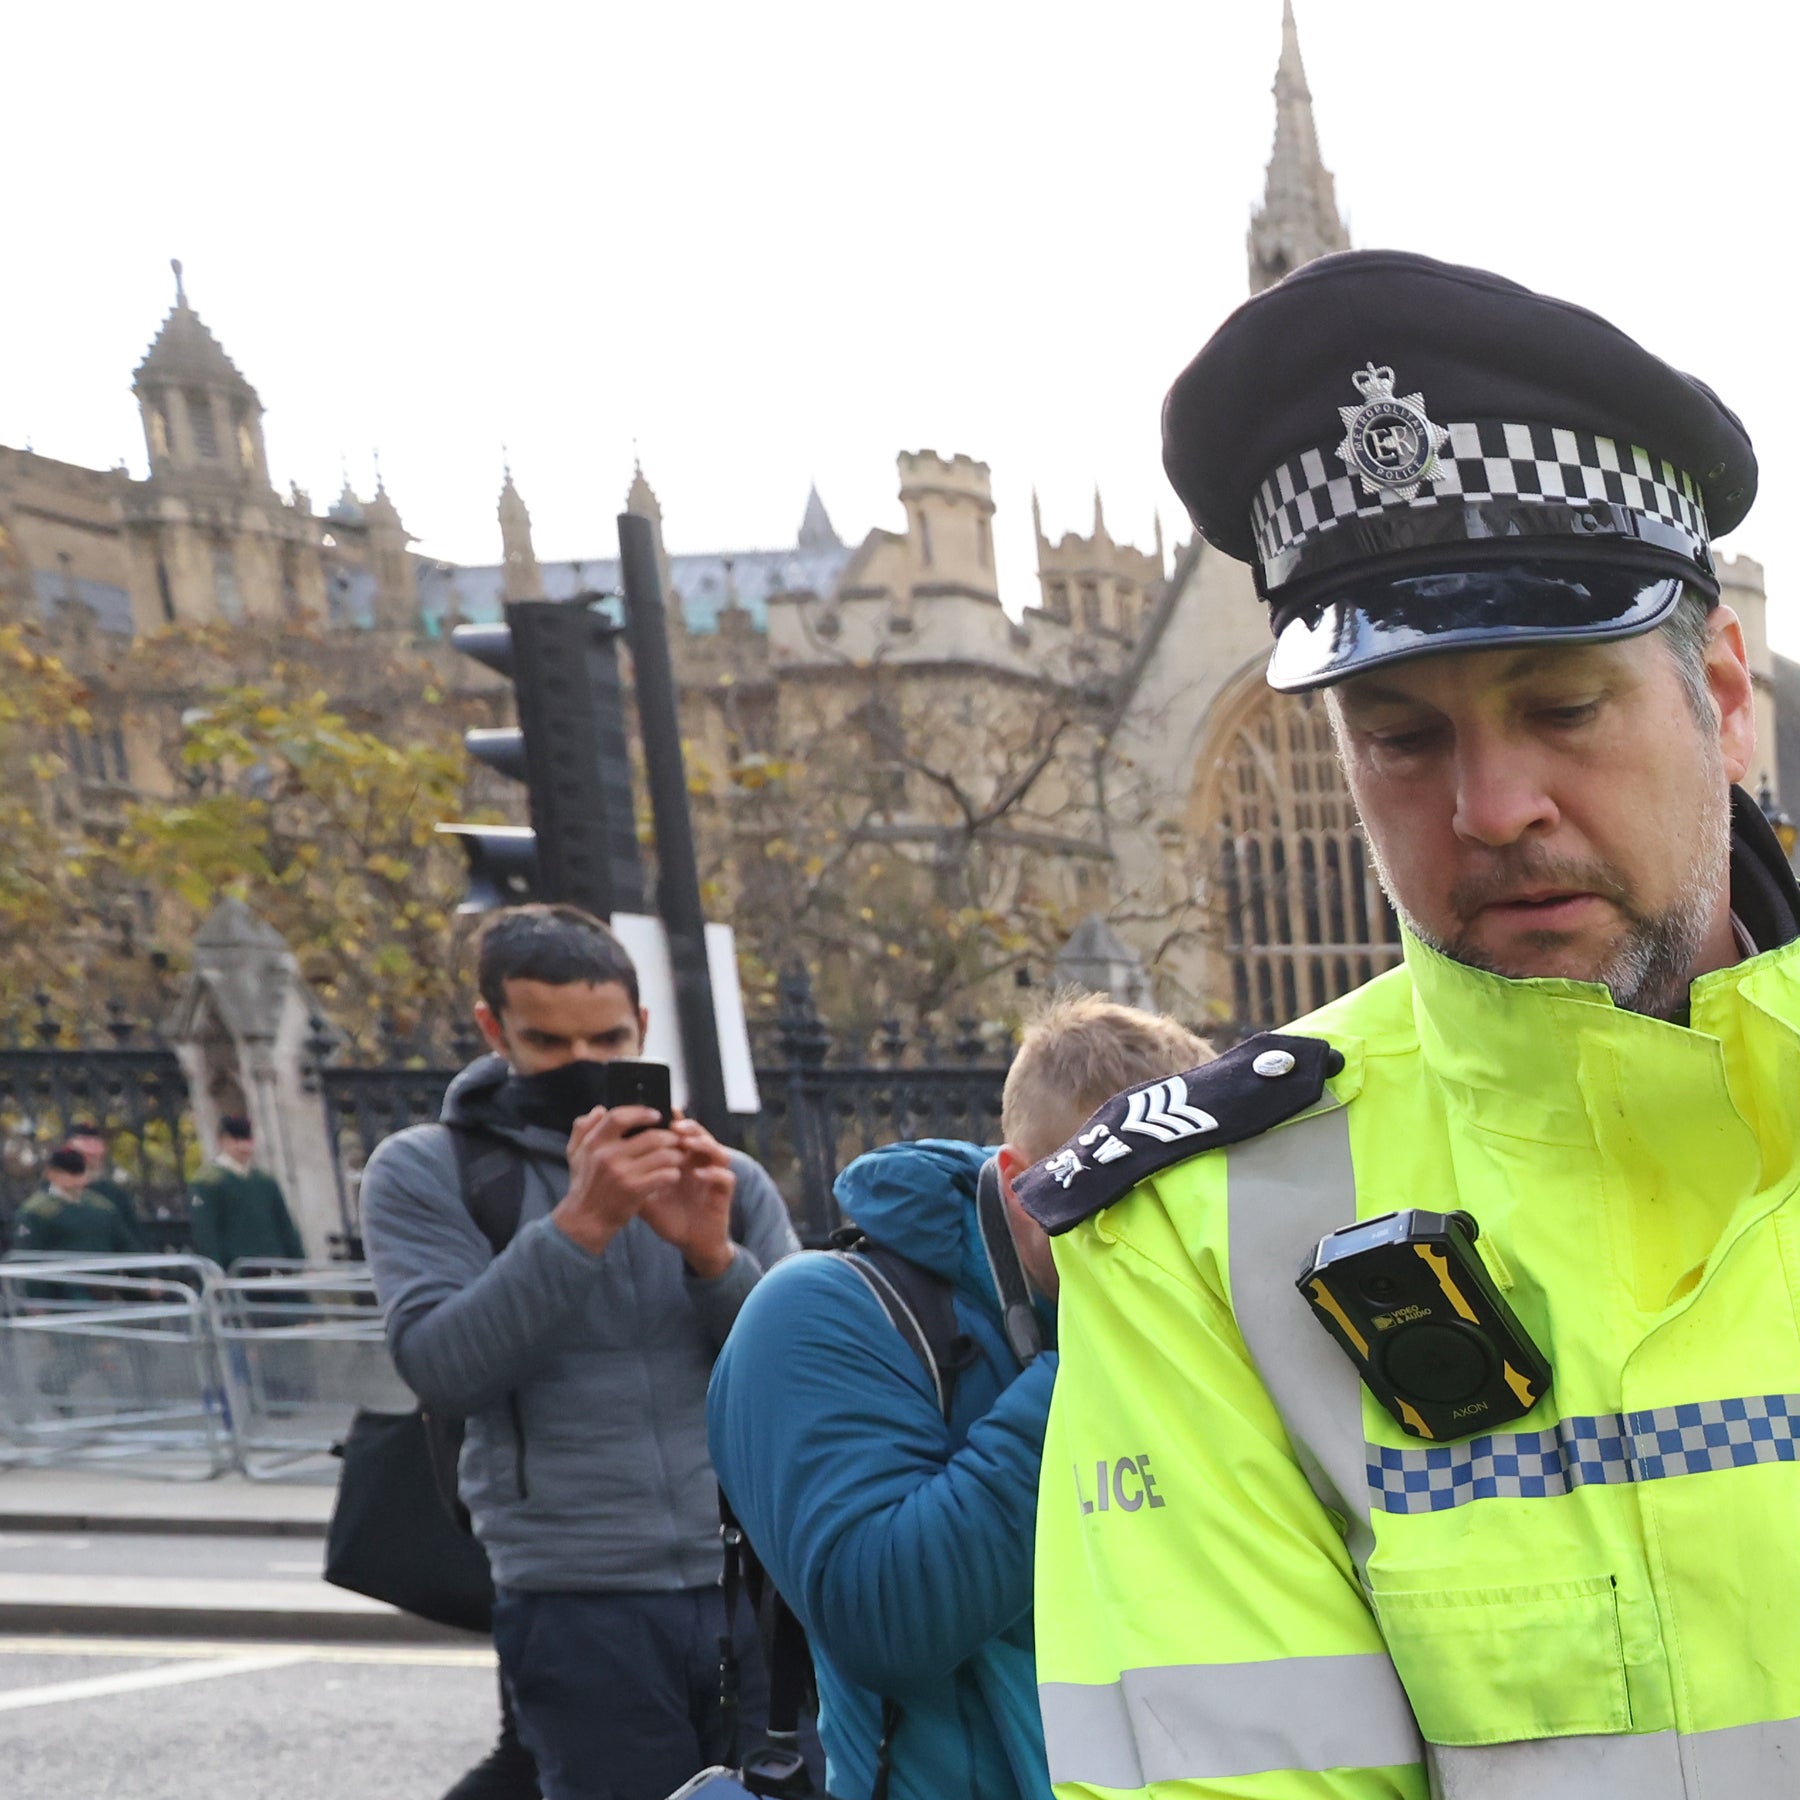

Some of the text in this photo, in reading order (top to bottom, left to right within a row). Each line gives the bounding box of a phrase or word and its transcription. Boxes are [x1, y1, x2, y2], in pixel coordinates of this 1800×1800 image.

[1354, 403, 1425, 451] METROPOLITAN
[1376, 460, 1422, 480] POLICE
[1078, 1124, 1132, 1164] SW
[1391, 1304, 1419, 1318] VIDEO
[1405, 1308, 1432, 1321] AUDIO
[1452, 1401, 1488, 1420] AXON
[1073, 1454, 1166, 1515] LICE
